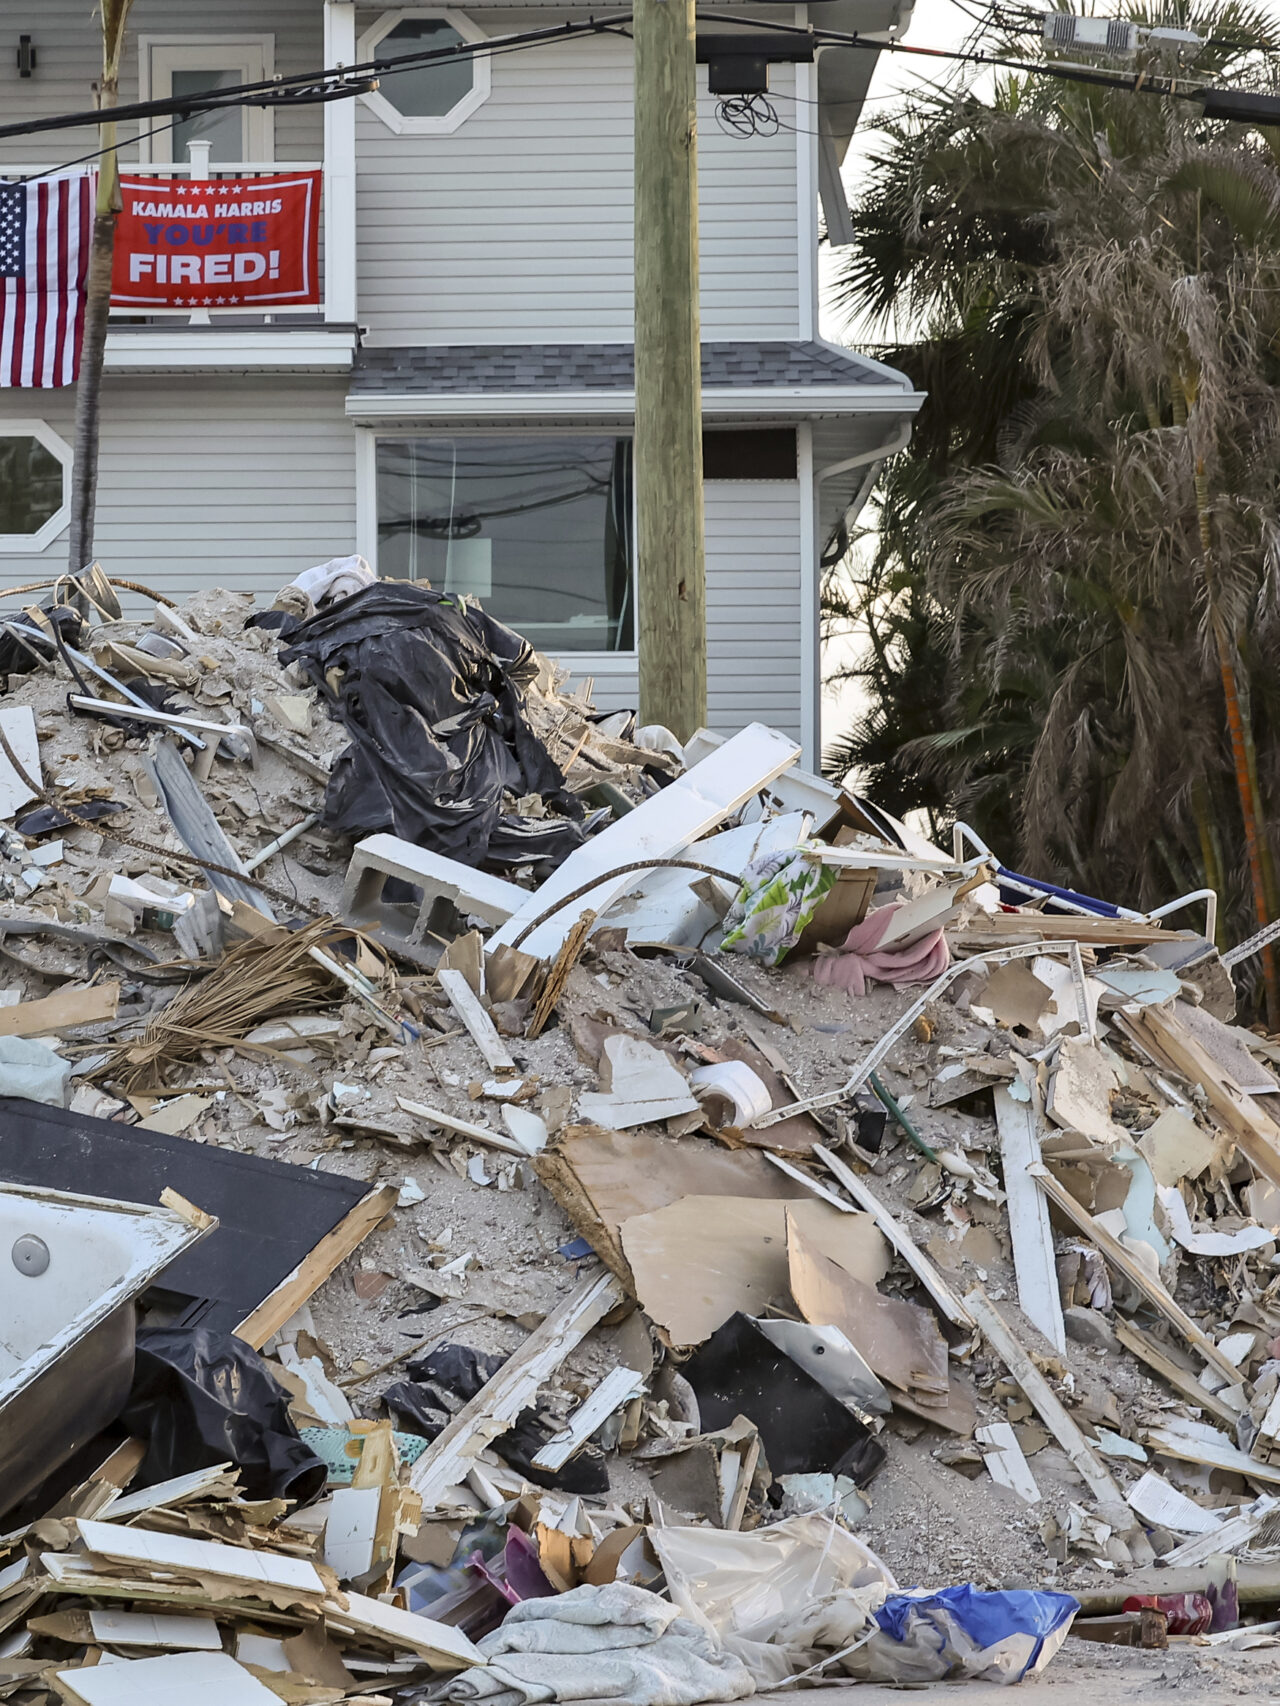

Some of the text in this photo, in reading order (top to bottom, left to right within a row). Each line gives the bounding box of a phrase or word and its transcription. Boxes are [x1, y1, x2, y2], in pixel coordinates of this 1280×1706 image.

[132, 199, 282, 218] KAMALA HARRIS
[143, 221, 268, 246] YOU'RE
[129, 250, 280, 284] FIRED!
